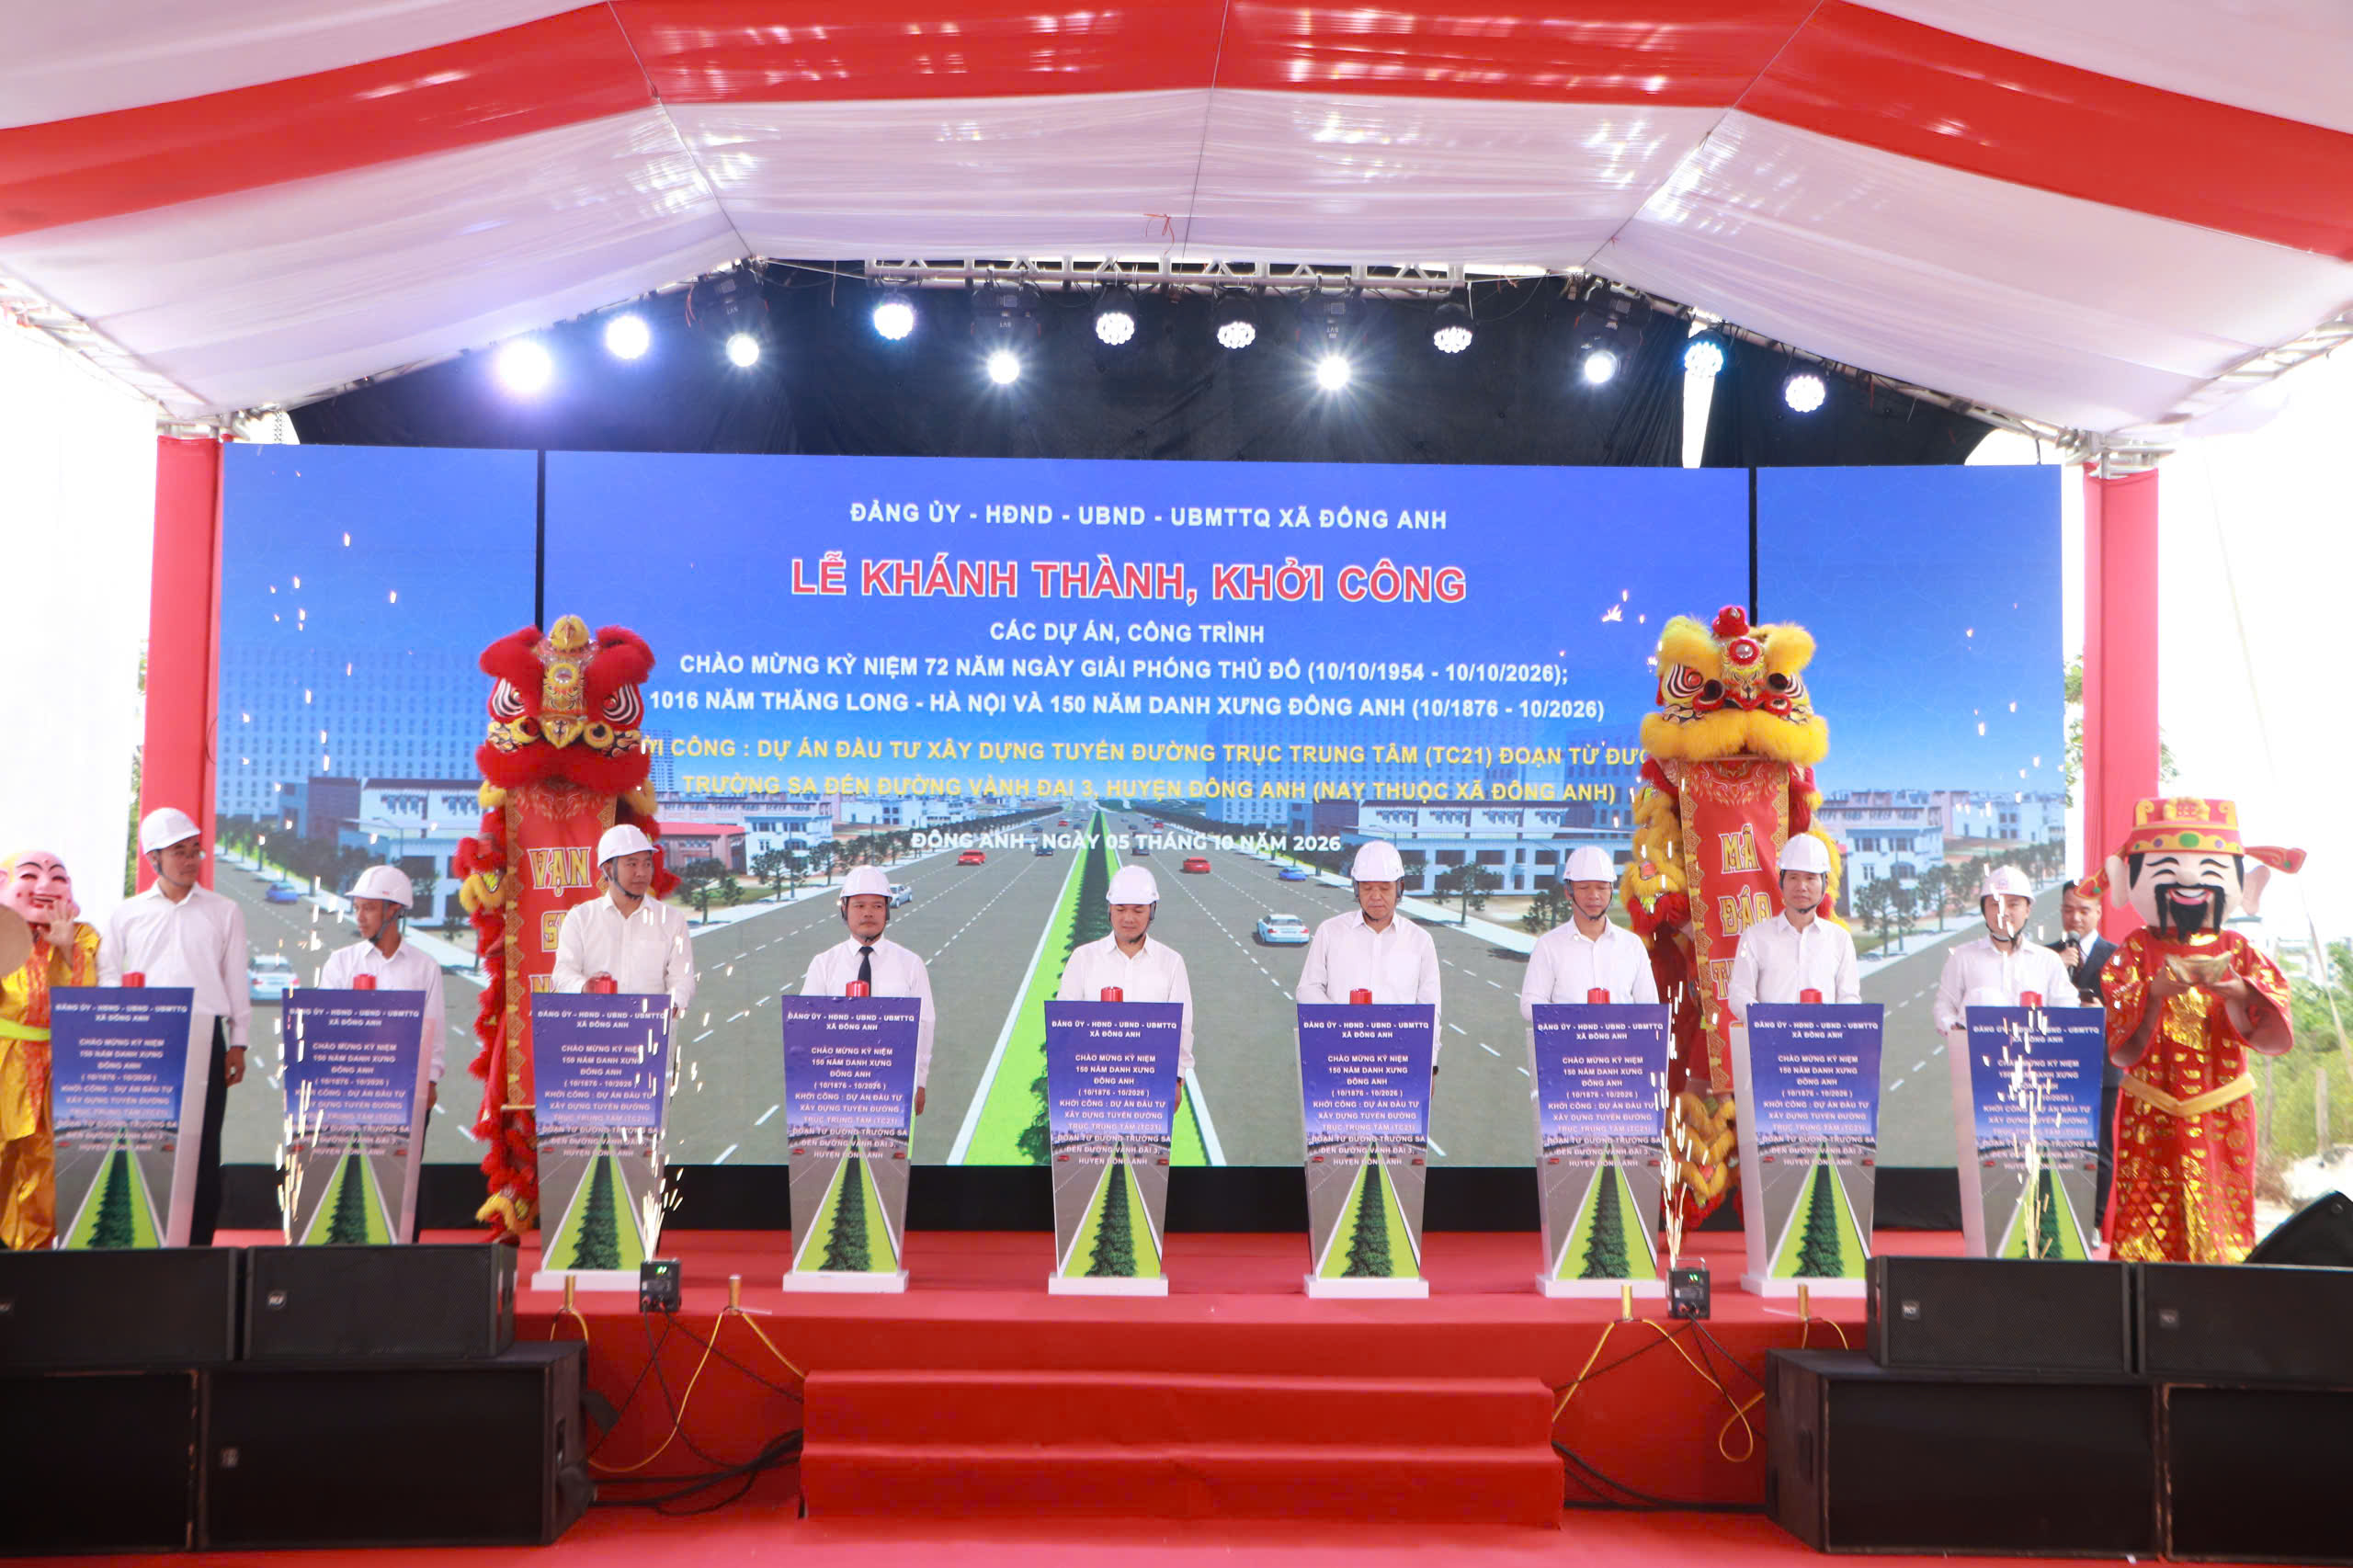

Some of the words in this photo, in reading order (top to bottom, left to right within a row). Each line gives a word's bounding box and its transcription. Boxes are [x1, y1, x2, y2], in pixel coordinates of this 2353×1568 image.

[850, 499, 919, 522] ĐẢNG
[930, 500, 961, 523] ỦY
[986, 505, 1052, 524] HĐND
[1079, 506, 1145, 525] UBND
[1171, 507, 1270, 528] UBMTTQ
[1279, 506, 1311, 528] XÃ
[1319, 506, 1388, 528] ĐÔNG
[1397, 510, 1446, 529] ANH
[792, 551, 846, 595] LỄ
[862, 552, 1017, 597] KHÁNH
[1031, 554, 1197, 605] THÀNH,
[1213, 557, 1324, 601] KHỞI
[1338, 558, 1466, 603] CÔNG
[991, 619, 1035, 640] CÁC
[1044, 623, 1077, 645] DỰ
[1083, 619, 1120, 644] ÁN,
[1128, 620, 1191, 642] CÔNG
[1199, 621, 1263, 642] TRÌNH
[680, 652, 744, 673] CHÀO
[752, 653, 819, 674] MỪNG
[827, 653, 857, 675] KỶ
[864, 656, 917, 679] NIỆM
[925, 657, 949, 676] 72
[957, 654, 1004, 676] NĂM
[1013, 655, 1074, 676] NGÀY
[1081, 655, 1125, 677] GIẢI
[1133, 656, 1211, 678] PHÓNG
[1218, 657, 1261, 679] THỦ
[1268, 658, 1301, 679] ĐÔ
[1309, 662, 1424, 684] (10/10/1954
[1446, 664, 1567, 686] 10/10/2026);
[650, 692, 699, 710] 1016
[706, 688, 754, 710] NĂM
[761, 688, 838, 710] THĂNG
[847, 693, 908, 711] LONG
[930, 690, 961, 711] HÀ
[969, 693, 1006, 716] NỘI
[1013, 691, 1043, 712] VÀ
[1051, 695, 1086, 713] 150
[1094, 692, 1141, 713] NĂM
[1149, 697, 1210, 714] DANH
[1217, 697, 1281, 715] XƯNG
[1288, 694, 1352, 716] ĐÔNG
[1358, 699, 1404, 716] ANH
[1413, 699, 1498, 721] (10/1876
[1520, 699, 1604, 722] 10/2026)
[671, 736, 735, 757] CÔNG
[758, 741, 790, 761] DỰ
[798, 737, 827, 757] ÁN
[836, 738, 881, 758] ĐẦU
[890, 742, 921, 759] TƯ
[928, 739, 972, 759] XÂY
[980, 743, 1044, 763] DỰNG
[1051, 741, 1123, 761] TUYẾN
[1132, 741, 1215, 762] ĐƯỜNG
[1222, 744, 1281, 767] TRỤC
[1290, 745, 1364, 763] TRUNG
[1372, 743, 1417, 764] TÂM
[1427, 746, 1492, 768] (TC21)
[1500, 747, 1561, 768] ĐOẠN
[1568, 744, 1599, 765] TỪ
[684, 773, 779, 794] TRƯỜNG
[789, 778, 816, 794] SA
[825, 775, 870, 795] ĐẾN
[878, 775, 961, 795] ĐƯỜNG
[969, 776, 1029, 796] VÀNH
[1037, 779, 1074, 797] ĐAI
[1082, 780, 1098, 800] 3,
[1107, 779, 1181, 801] HUYỆN
[1188, 777, 1252, 799] ĐÔNG
[1259, 782, 1305, 799] ANH
[1313, 782, 1366, 802] (NAY
[1373, 781, 1449, 803] THUỘC
[1456, 779, 1485, 800] XÃ
[1492, 779, 1555, 801] ĐÔNG
[1561, 784, 1616, 805] ANH)
[911, 829, 972, 849] ĐÔNG
[979, 834, 1026, 849] ANH
[1042, 830, 1100, 849] NGÀY
[1106, 835, 1130, 850] 05
[1135, 831, 1206, 850] THÁNG
[1213, 835, 1233, 850] 10
[1241, 832, 1287, 851] NĂM
[1293, 835, 1341, 852] 2026
[1719, 824, 1762, 874] MÃ
[527, 846, 593, 897] VẠN
